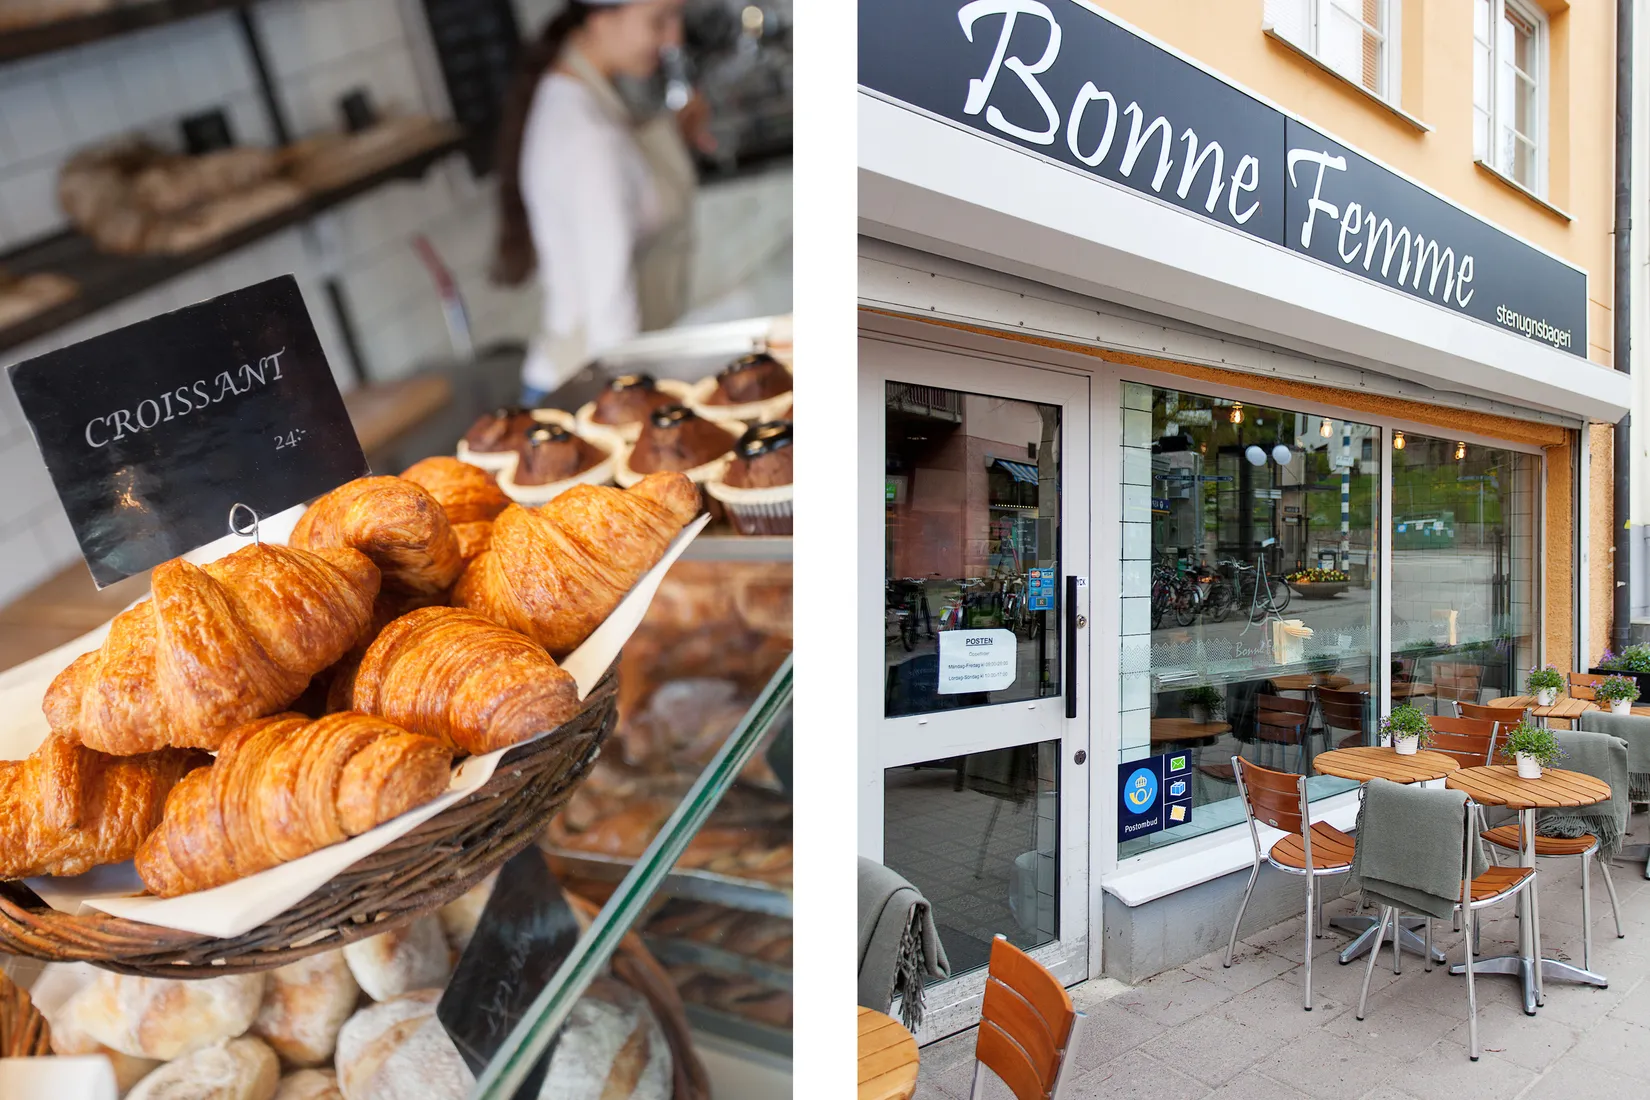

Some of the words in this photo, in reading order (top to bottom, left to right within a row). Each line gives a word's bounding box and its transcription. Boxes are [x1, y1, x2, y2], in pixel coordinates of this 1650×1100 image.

[958, 0, 1260, 224] Bonne
[1287, 148, 1475, 308] Femme
[1496, 304, 1571, 348] stenugnsbageri
[84, 346, 286, 448] CROISSANT
[965, 637, 993, 645] POSTEN
[1124, 817, 1158, 833] Postombud
